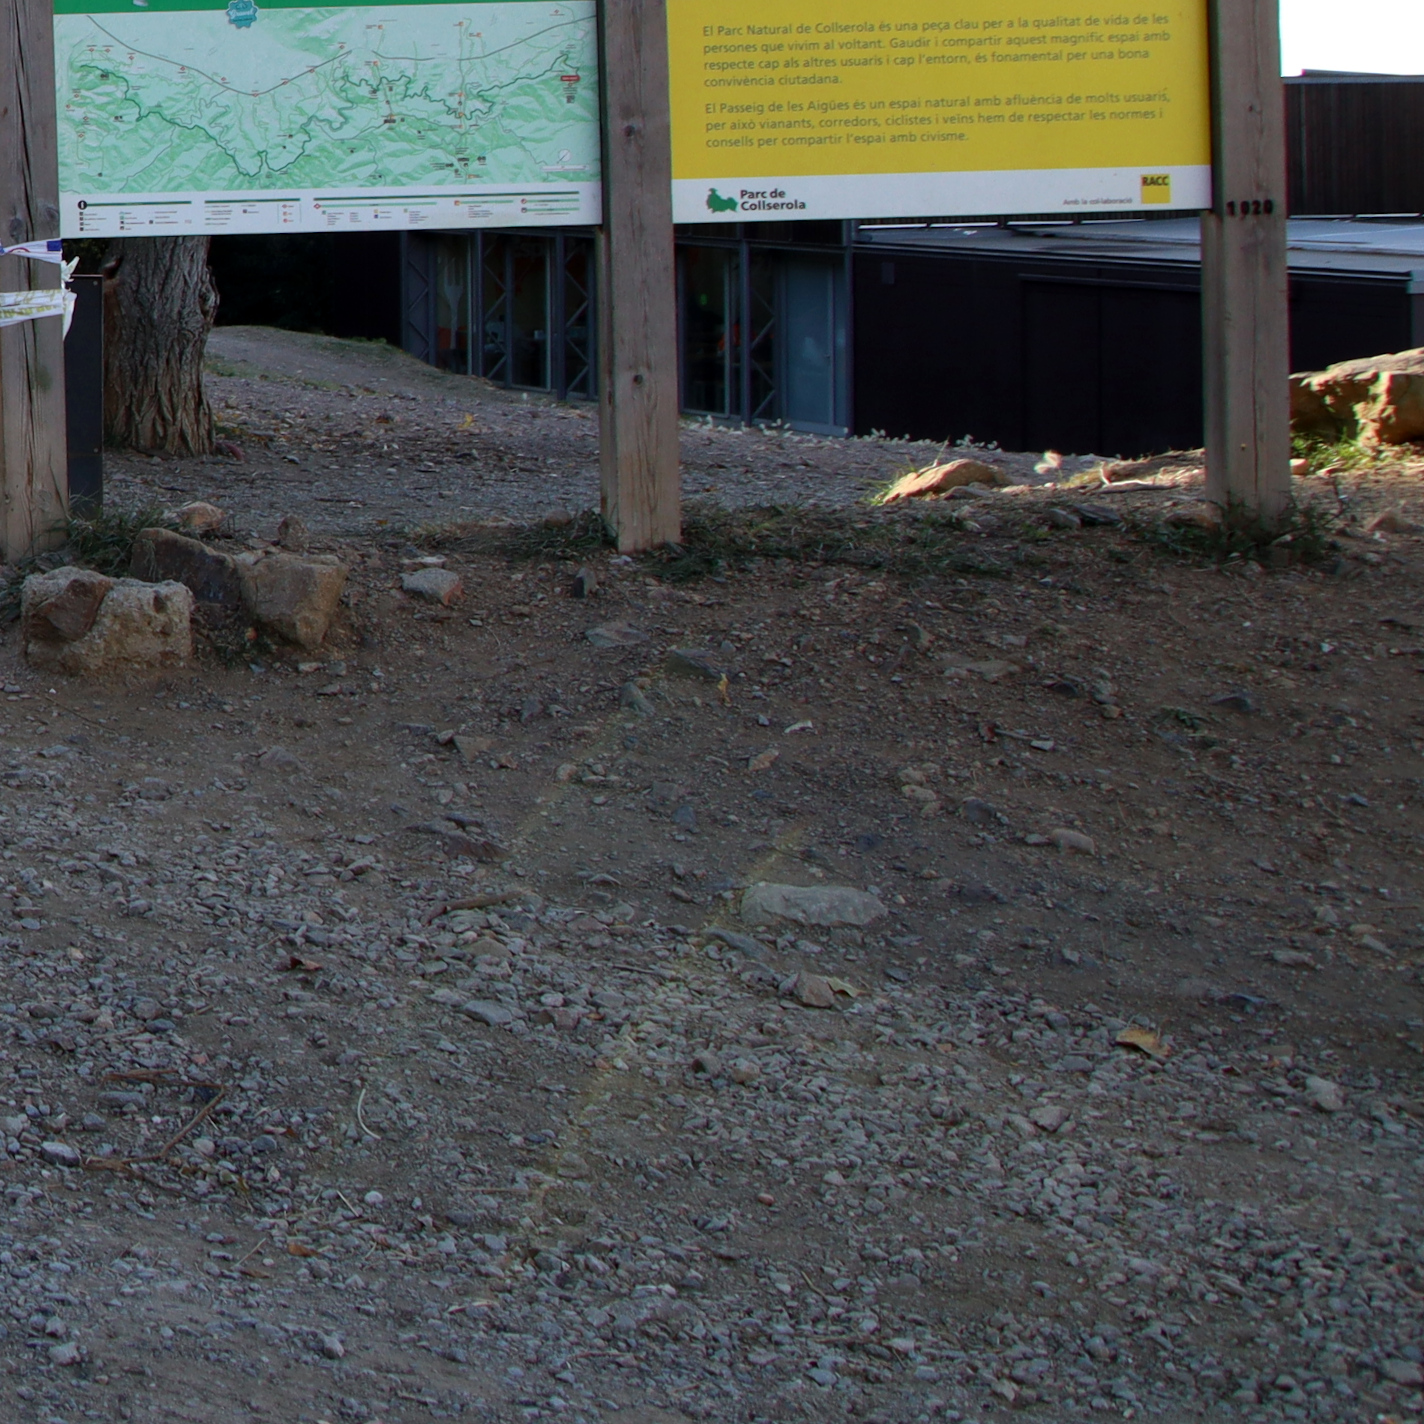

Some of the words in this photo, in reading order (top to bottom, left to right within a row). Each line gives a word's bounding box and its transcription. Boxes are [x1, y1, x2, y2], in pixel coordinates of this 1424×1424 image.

[702, 25, 714, 37] El
[717, 25, 743, 36] Parc
[746, 24, 793, 35] Natural
[795, 23, 812, 34] de
[814, 21, 876, 33] Collserola
[878, 21, 892, 32] és
[894, 22, 918, 31] una
[921, 21, 951, 32] peça
[953, 19, 979, 29] clau
[982, 20, 1003, 30] per
[1018, 17, 1030, 28] la
[1032, 16, 1081, 29] qualitat
[1084, 15, 1101, 26] de
[1103, 14, 1130, 25] vida
[1132, 14, 1149, 25] de
[1152, 13, 1169, 24] les
[703, 43, 758, 55] persones
[760, 42, 785, 54] que
[787, 40, 820, 51] vivim
[823, 39, 835, 50] al
[837, 39, 886, 49] voltant.
[889, 37, 931, 48] Gaudir
[941, 35, 1002, 47] compartir
[1005, 35, 1047, 46] aquest
[1107, 31, 1140, 43] espai
[1143, 30, 1171, 41] amb
[703, 60, 756, 71] respecte
[757, 59, 780, 70] cap
[783, 57, 800, 68] als
[802, 57, 838, 67] altres
[840, 55, 883, 67] usuaris
[893, 56, 915, 66] cap
[918, 54, 971, 64] l'entorn,
[974, 52, 988, 63] és
[991, 51, 1063, 62] fonamental
[1066, 51, 1087, 62] per
[1090, 50, 1115, 60] una
[1118, 49, 1150, 59] bona
[703, 75, 775, 87] convivència
[778, 74, 842, 85] ciutadana.
[705, 102, 716, 114] El
[719, 102, 765, 115] Passeig
[767, 101, 784, 112] de
[786, 100, 804, 112] les
[806, 100, 850, 113] Aigües
[852, 99, 866, 110] és
[869, 100, 886, 110] un
[888, 99, 921, 110] espai
[924, 96, 970, 108] natural
[973, 95, 1002, 106] amb
[1065, 93, 1082, 104] de
[1085, 93, 1121, 103] molts
[705, 121, 726, 133] per
[729, 119, 756, 130] això
[758, 118, 815, 129] vianants,
[818, 116, 881, 128] corredors,
[885, 114, 933, 126] ciclistes
[977, 112, 1005, 123] hem
[1008, 111, 1025, 123] de
[1027, 112, 1086, 123] respectar
[1089, 109, 1106, 120] les
[1109, 110, 1156, 119] normes
[705, 135, 754, 147] consells
[757, 137, 778, 148] per
[781, 134, 843, 146] compartir
[846, 133, 886, 145] l'espai
[889, 132, 917, 143] amb
[919, 132, 969, 141] civisme.
[1142, 175, 1169, 186] RACC
[740, 189, 767, 202] Parc
[769, 188, 785, 199] de
[740, 199, 806, 211] Collserola
[1226, 200, 1273, 215] 1020
